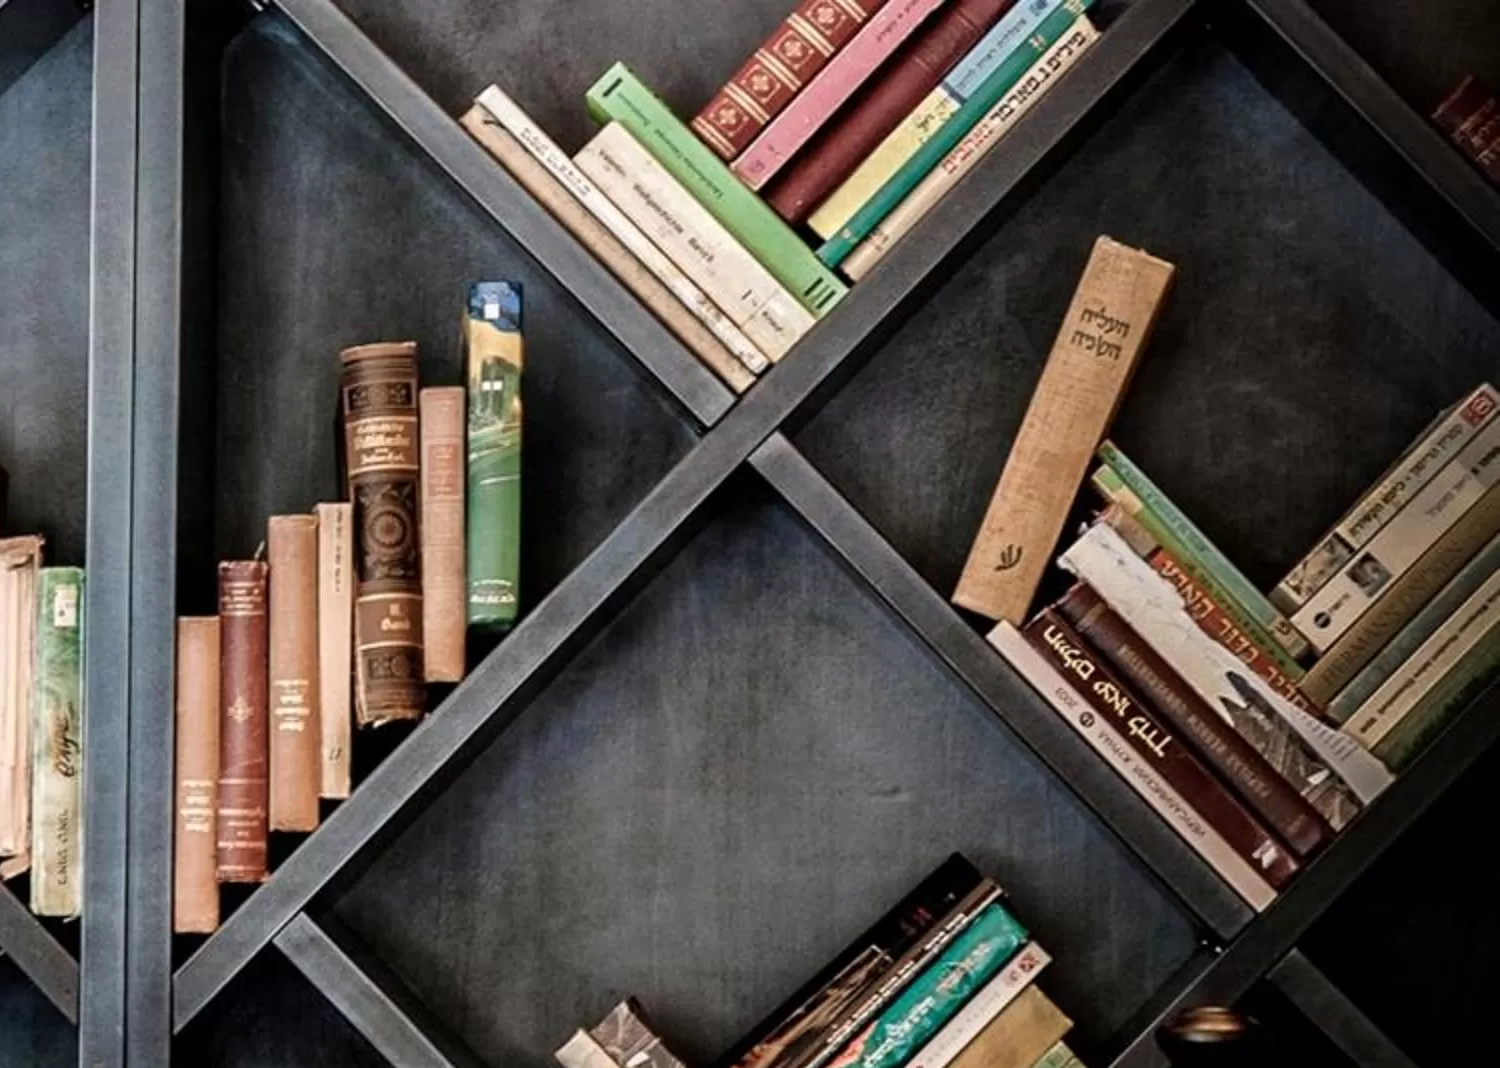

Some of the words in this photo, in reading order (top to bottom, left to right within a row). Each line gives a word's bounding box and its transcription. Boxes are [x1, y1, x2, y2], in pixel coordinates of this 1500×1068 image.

[1036, 622, 1098, 684] חיילים
[1090, 674, 1134, 718] יצאו
[1122, 707, 1176, 761] לדרך
